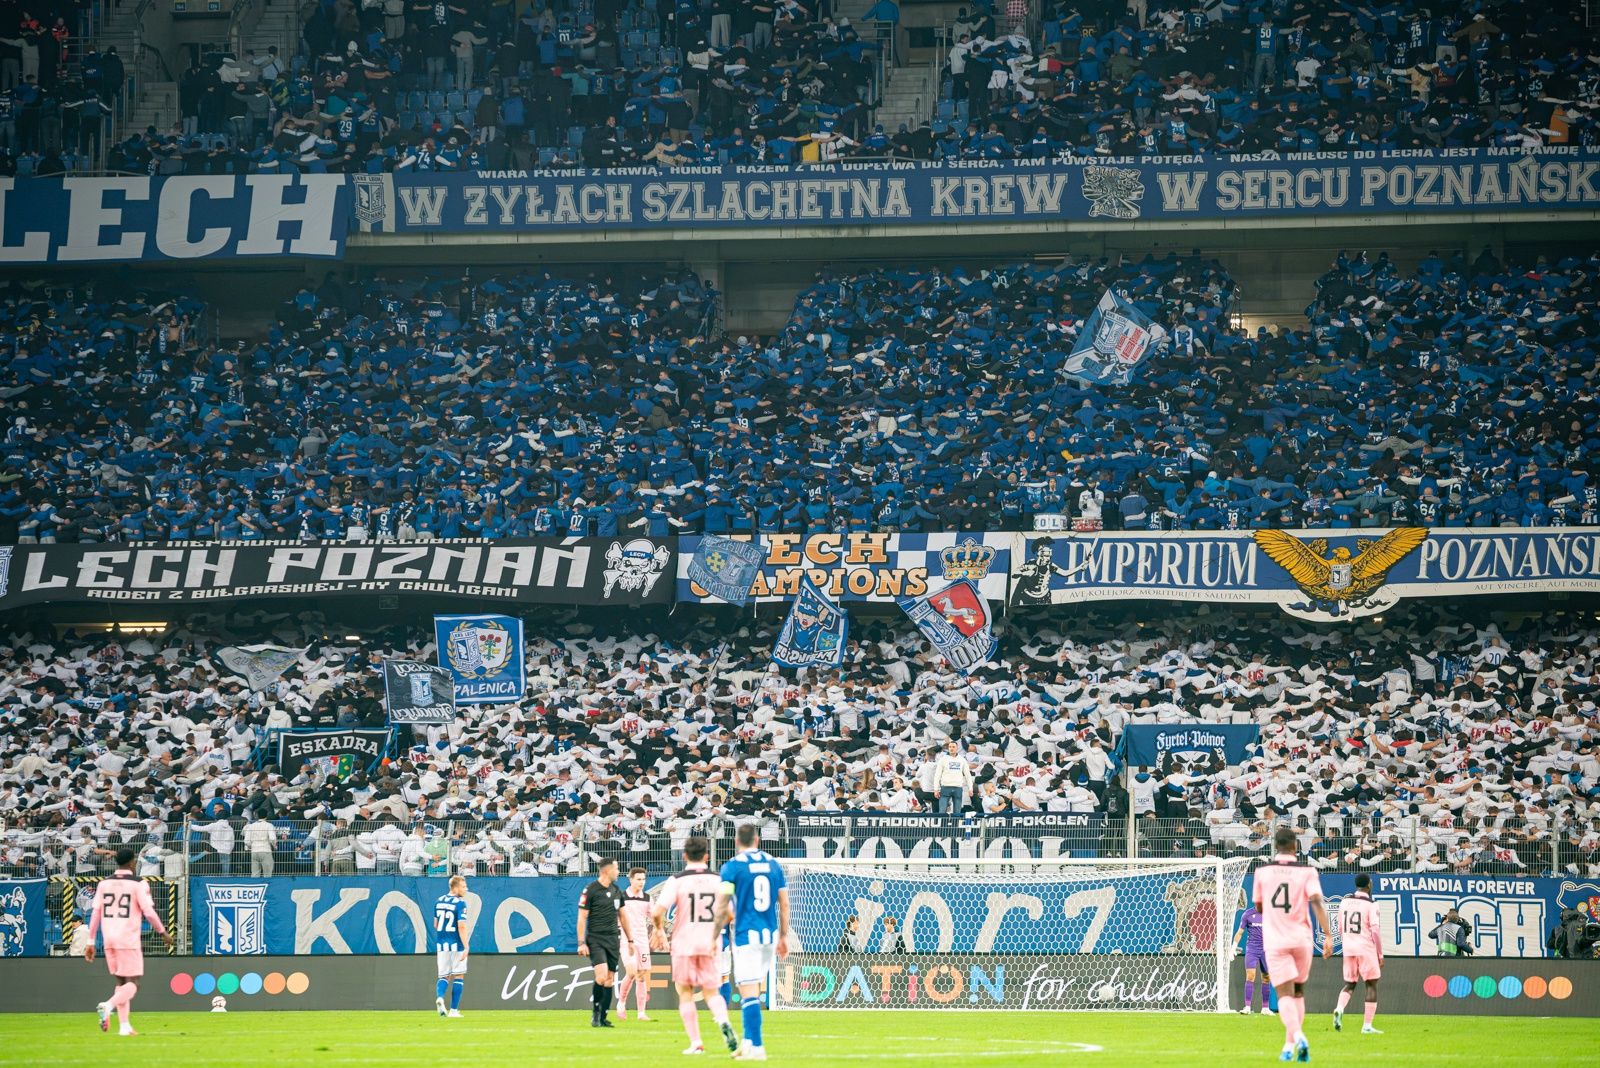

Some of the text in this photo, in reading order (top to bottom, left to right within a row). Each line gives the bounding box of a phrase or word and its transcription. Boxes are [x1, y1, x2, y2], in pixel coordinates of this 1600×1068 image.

[477, 169, 528, 179] WIARA
[533, 167, 586, 178] PŁYNIE
[591, 168, 601, 177] Z
[670, 165, 722, 175] HONOR
[736, 163, 789, 174] RAZEM
[921, 158, 942, 170] DO
[1012, 158, 1046, 167] TAM
[1052, 155, 1135, 166] POWSTAJE
[1141, 154, 1204, 168] POTĘGA
[1230, 150, 1281, 162] NASZA
[1354, 149, 1375, 160] DO
[1382, 149, 1434, 159] LECHA
[1439, 147, 1478, 158] JEST
[1487, 145, 1579, 157] NAPRAWDĘ
[398, 186, 447, 225] W
[642, 176, 912, 222] SZLACHETNA
[930, 173, 1069, 217] KREW
[1157, 171, 1208, 212] W
[1216, 166, 1351, 211] SERCU
[731, 533, 888, 565] ECH
[1064, 540, 1258, 586] IMPERIUM
[22, 537, 591, 592] LECH POZNAŃ
[690, 567, 927, 597] AMPIONS
[288, 735, 379, 758] ESKADRA
[1156, 732, 1188, 751] Fyrtel
[857, 816, 942, 828] STADIONU
[1012, 813, 1089, 827] POKOLEŃ
[214, 889, 260, 900] KKS LECH
[752, 875, 771, 912] 9
[1271, 883, 1292, 914] 4
[1380, 877, 1536, 895] PYRLANDIA FOREVER
[103, 893, 132, 919] 29
[436, 909, 456, 932] 72
[688, 893, 716, 923] 13
[1343, 910, 1362, 935] 19
[1373, 894, 1547, 958] LECH
[1023, 963, 1077, 1010] for
